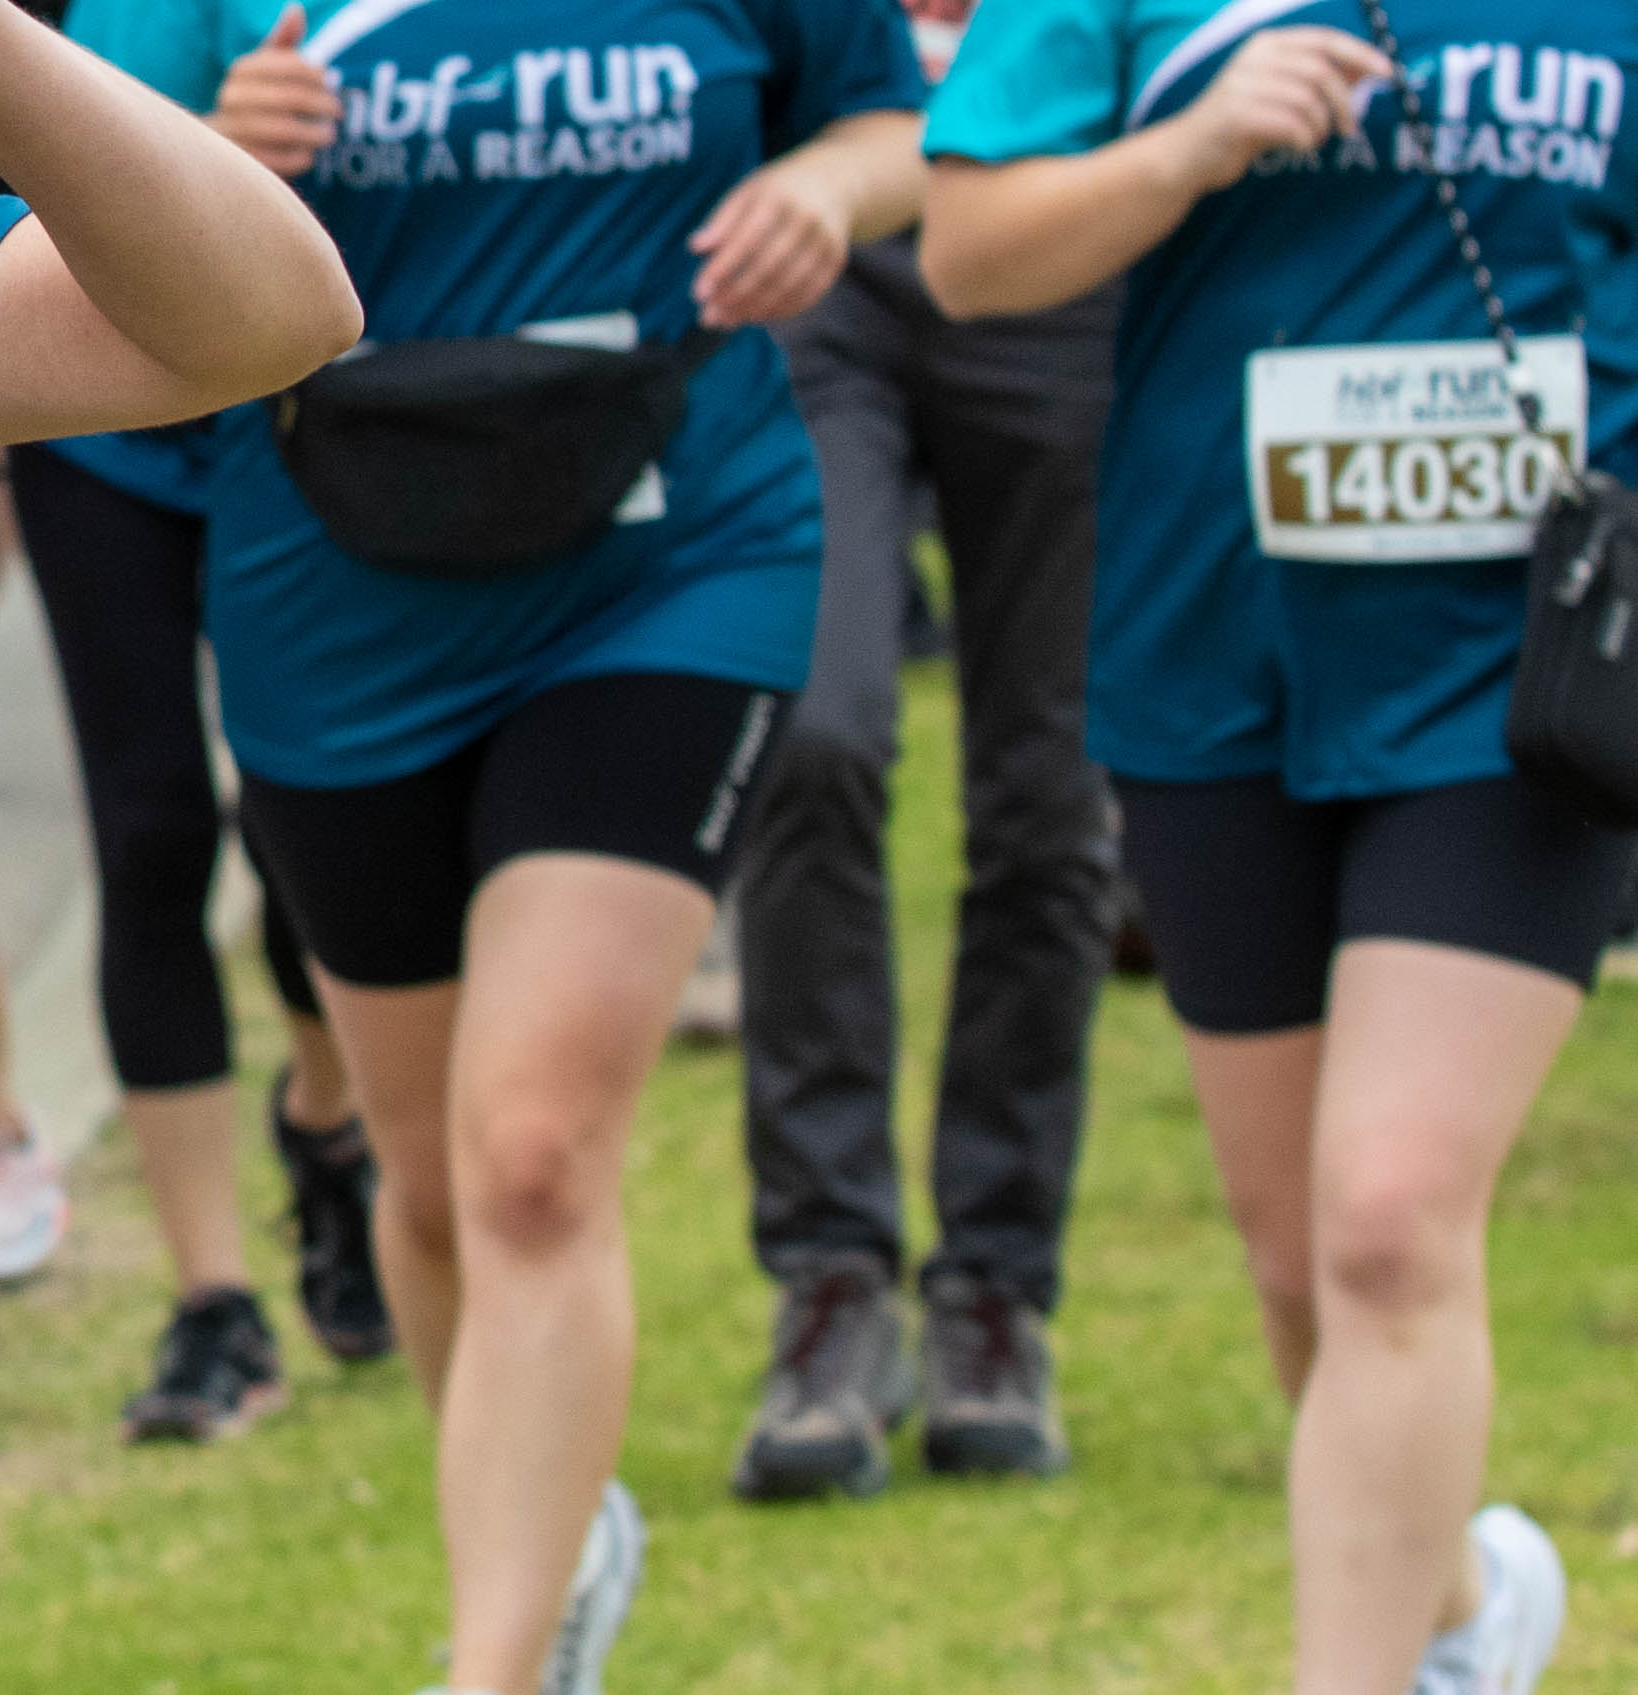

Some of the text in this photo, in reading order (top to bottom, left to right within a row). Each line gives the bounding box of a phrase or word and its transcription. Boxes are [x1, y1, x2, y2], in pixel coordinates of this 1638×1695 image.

[512, 42, 698, 126] run
[1440, 41, 1625, 136] run
[474, 116, 693, 181] REASON
[1285, 434, 1555, 523] 14030
